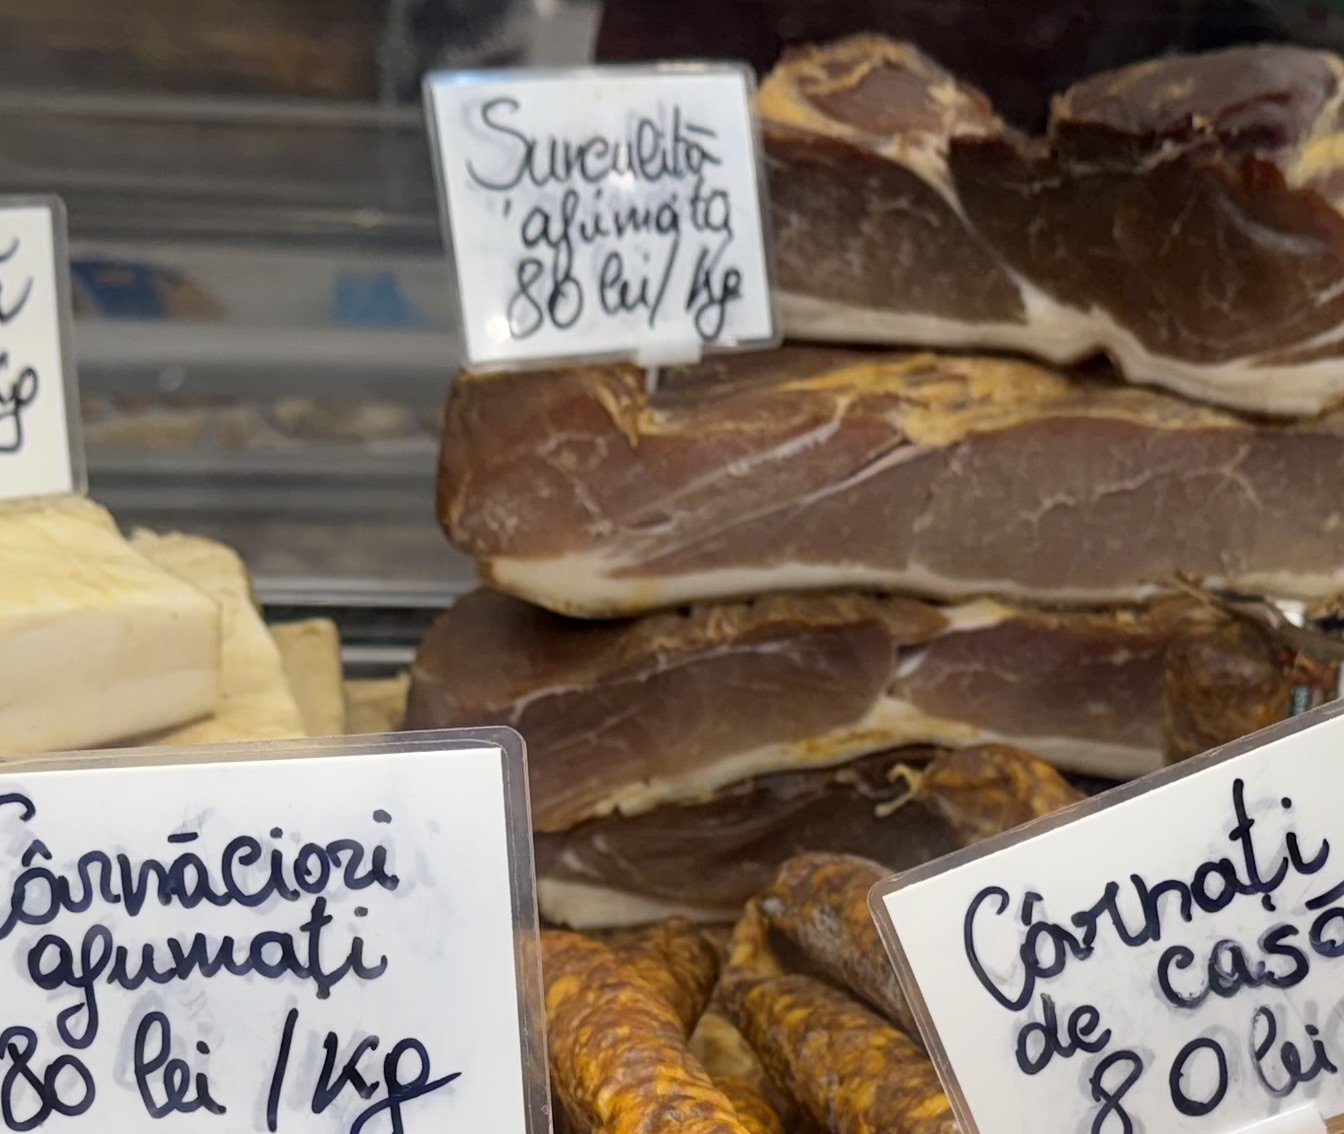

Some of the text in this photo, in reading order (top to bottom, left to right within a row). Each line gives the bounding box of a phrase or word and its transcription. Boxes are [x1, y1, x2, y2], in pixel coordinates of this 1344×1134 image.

[508, 258, 583, 338] 80
[600, 251, 650, 315] lei
[963, 777, 1329, 1012] Cârnați
[27, 897, 388, 1050] afumați
[134, 1011, 226, 1119] lei
[1015, 992, 1112, 1075] de
[1249, 1008, 1338, 1096] lei
